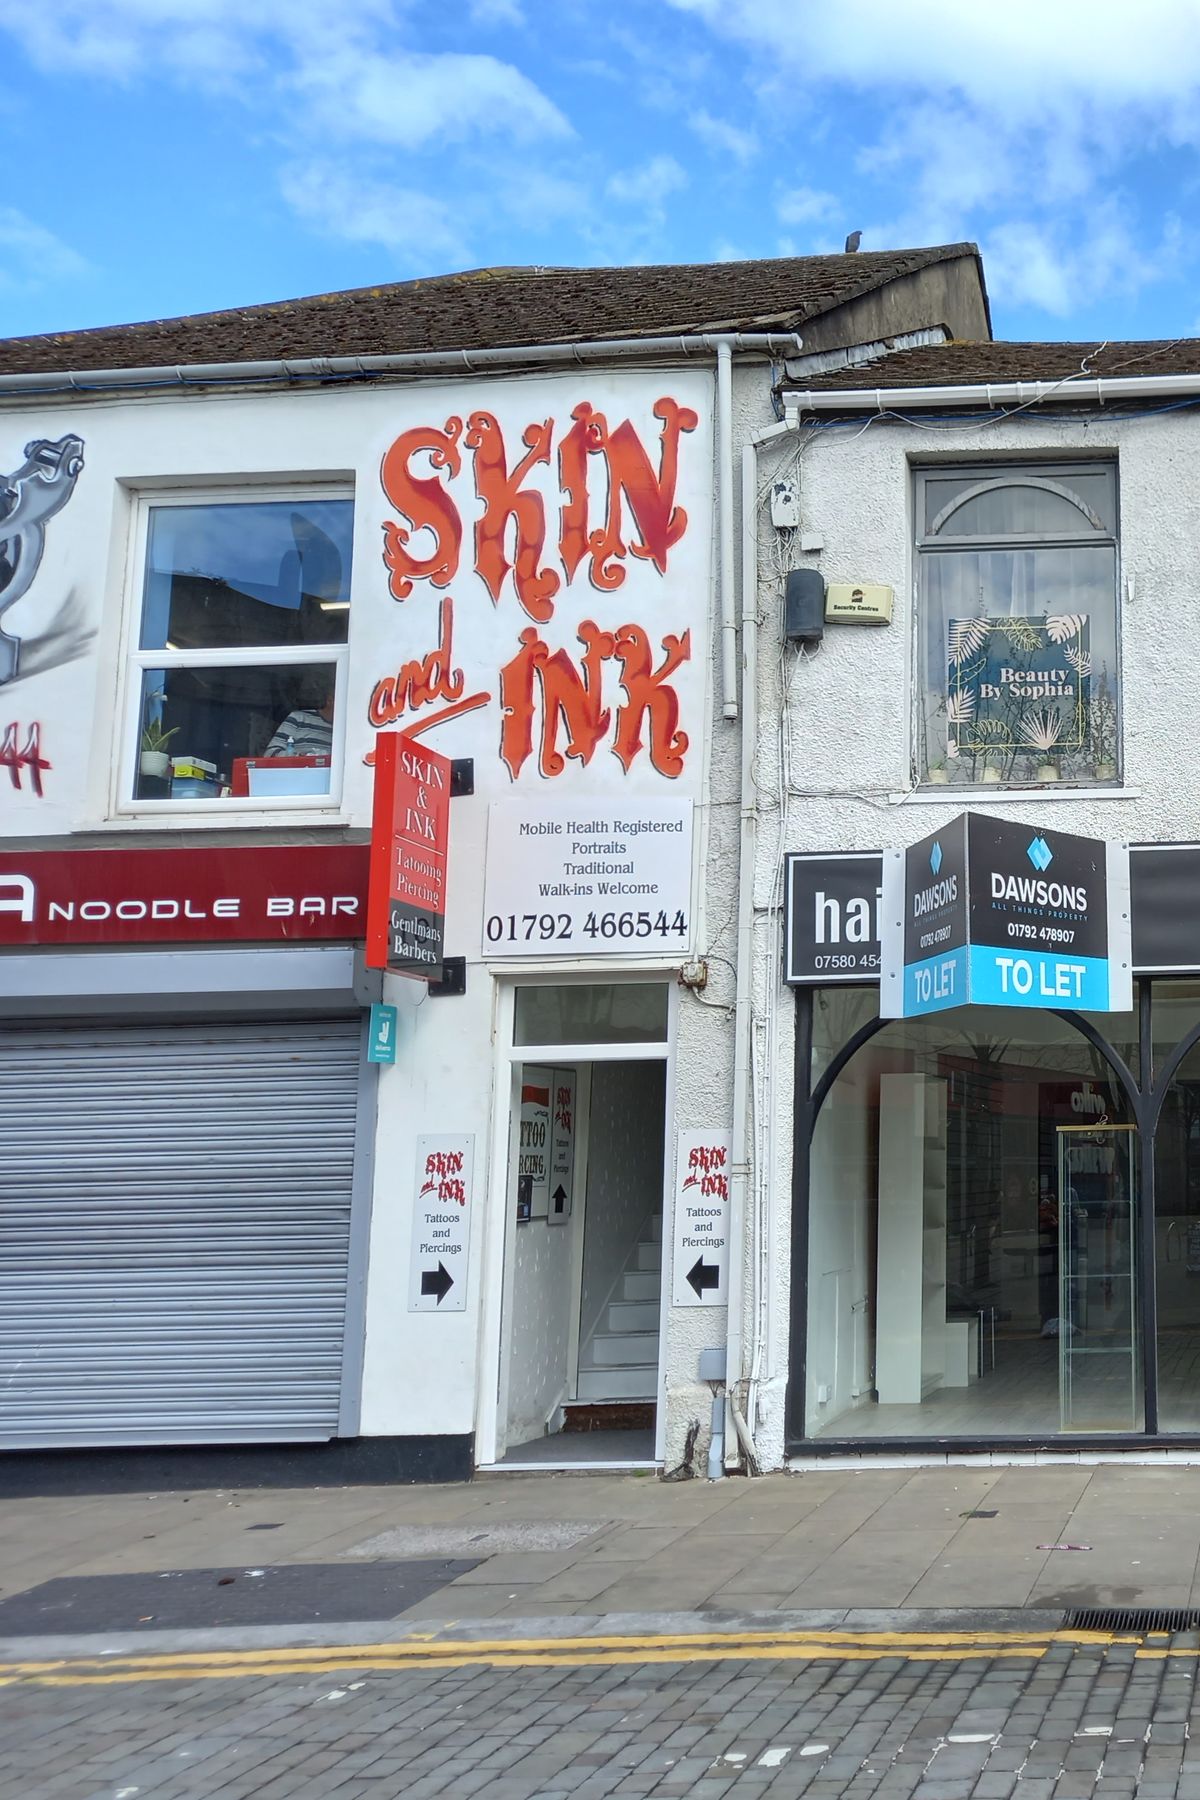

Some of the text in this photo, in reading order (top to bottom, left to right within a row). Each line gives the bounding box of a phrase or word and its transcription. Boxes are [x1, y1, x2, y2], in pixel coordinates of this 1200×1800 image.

[380, 397, 698, 623] SKIN
[1000, 667, 1069, 684] Beauty
[368, 598, 691, 782] and INK
[980, 682, 1074, 700] By Sophia
[401, 751, 444, 790] SKIN
[416, 786, 427, 809] &
[406, 808, 436, 841] INK
[520, 820, 683, 836] Mobile Health Registered
[572, 841, 627, 854] Portraits
[564, 862, 634, 875] Traditional
[396, 873, 440, 909] Piercing
[538, 882, 658, 896] Walk-ins Welcome
[914, 875, 958, 918] DAWSONS
[991, 872, 1088, 912] DAWSONS
[48, 898, 240, 921] NOODLE
[267, 894, 359, 917] BAR
[815, 887, 882, 944] hai
[992, 902, 1088, 922] ALL THINGS PROPERTY
[486, 910, 688, 942] 01792 466544
[1008, 922, 1074, 943] 01792 478907
[394, 935, 437, 963] Barbers
[815, 955, 856, 968] 07580
[914, 960, 957, 1004] TO LET
[995, 957, 1087, 998] TO LET
[520, 1121, 546, 1148] TTOO
[426, 1151, 464, 1179] SKIN
[518, 1155, 544, 1174] RCING
[688, 1146, 727, 1174] SKIN
[438, 1178, 466, 1206] INK
[700, 1173, 728, 1202] INK
[424, 1214, 460, 1224] Tattoos
[686, 1207, 722, 1217] Tattoos
[432, 1228, 450, 1238] and
[694, 1222, 712, 1232] and
[420, 1243, 462, 1254] Piercings
[682, 1237, 725, 1248] Piercings
